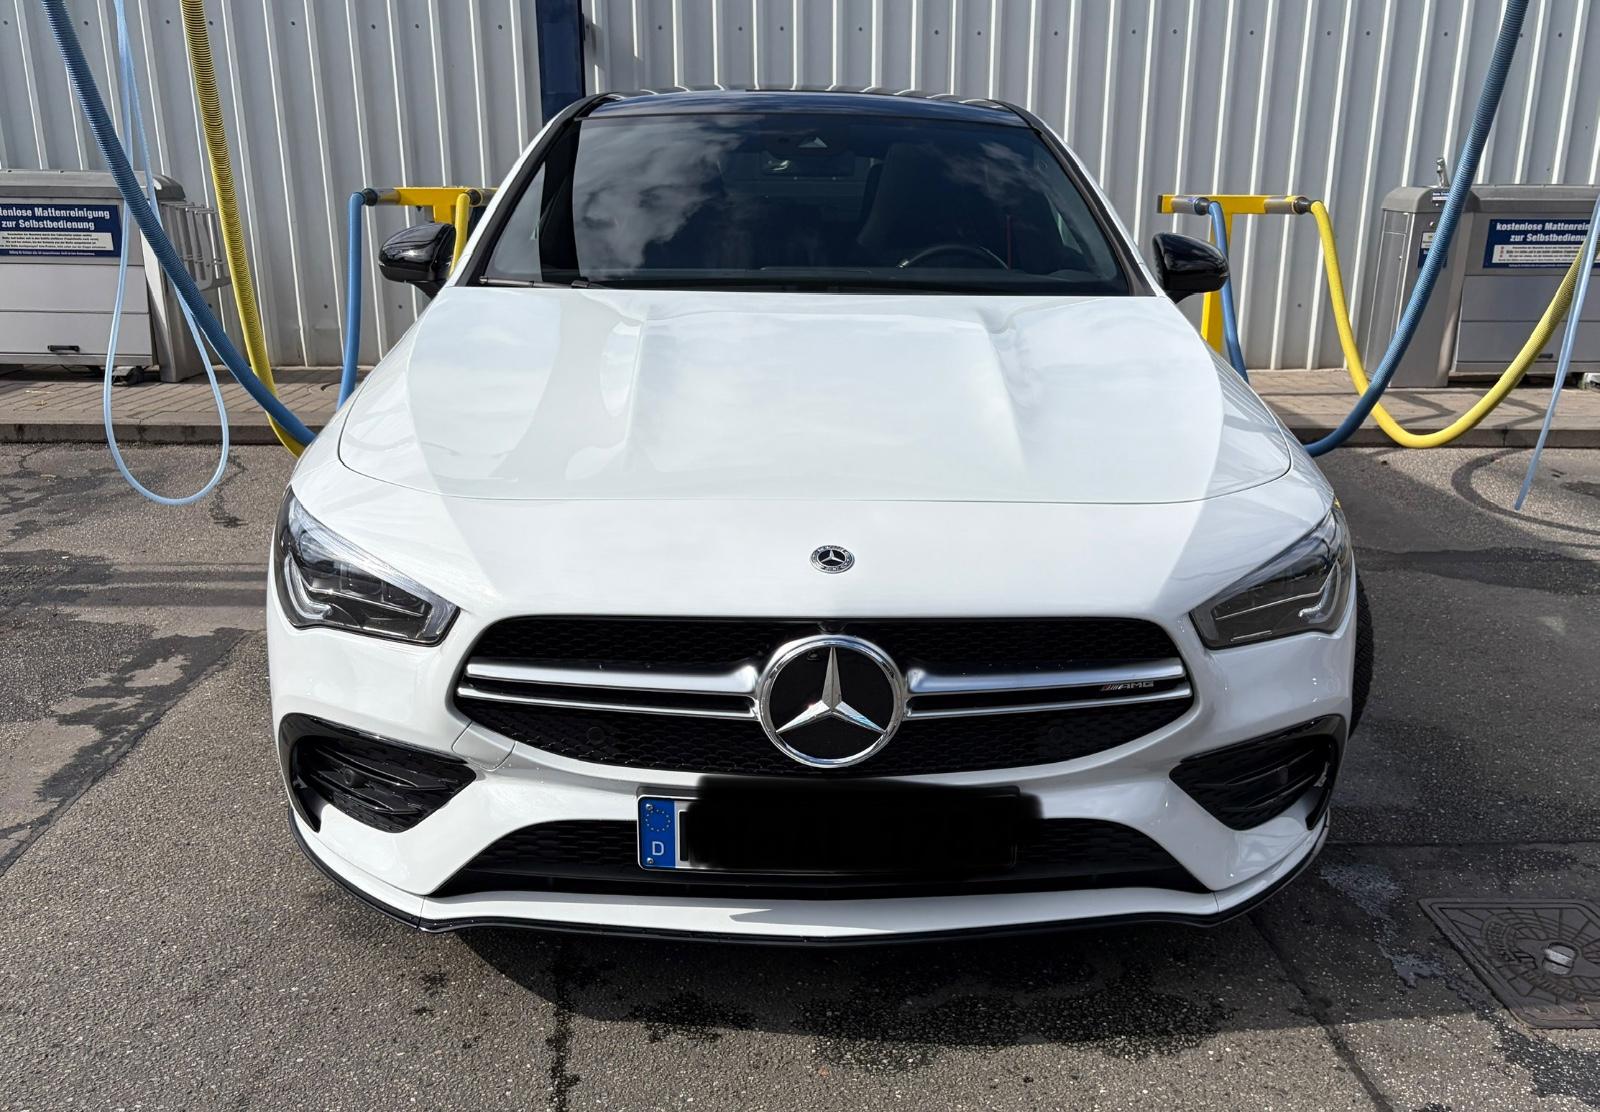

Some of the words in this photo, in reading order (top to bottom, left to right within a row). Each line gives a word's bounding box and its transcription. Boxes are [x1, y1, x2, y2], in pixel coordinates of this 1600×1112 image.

[34, 207, 110, 219] Mattenreinigung
[2, 220, 16, 228] zur
[19, 220, 95, 230] Selbstbedienung
[1496, 222, 1543, 231] kostenlose
[1510, 234, 1525, 242] zur
[652, 841, 665, 856] D
